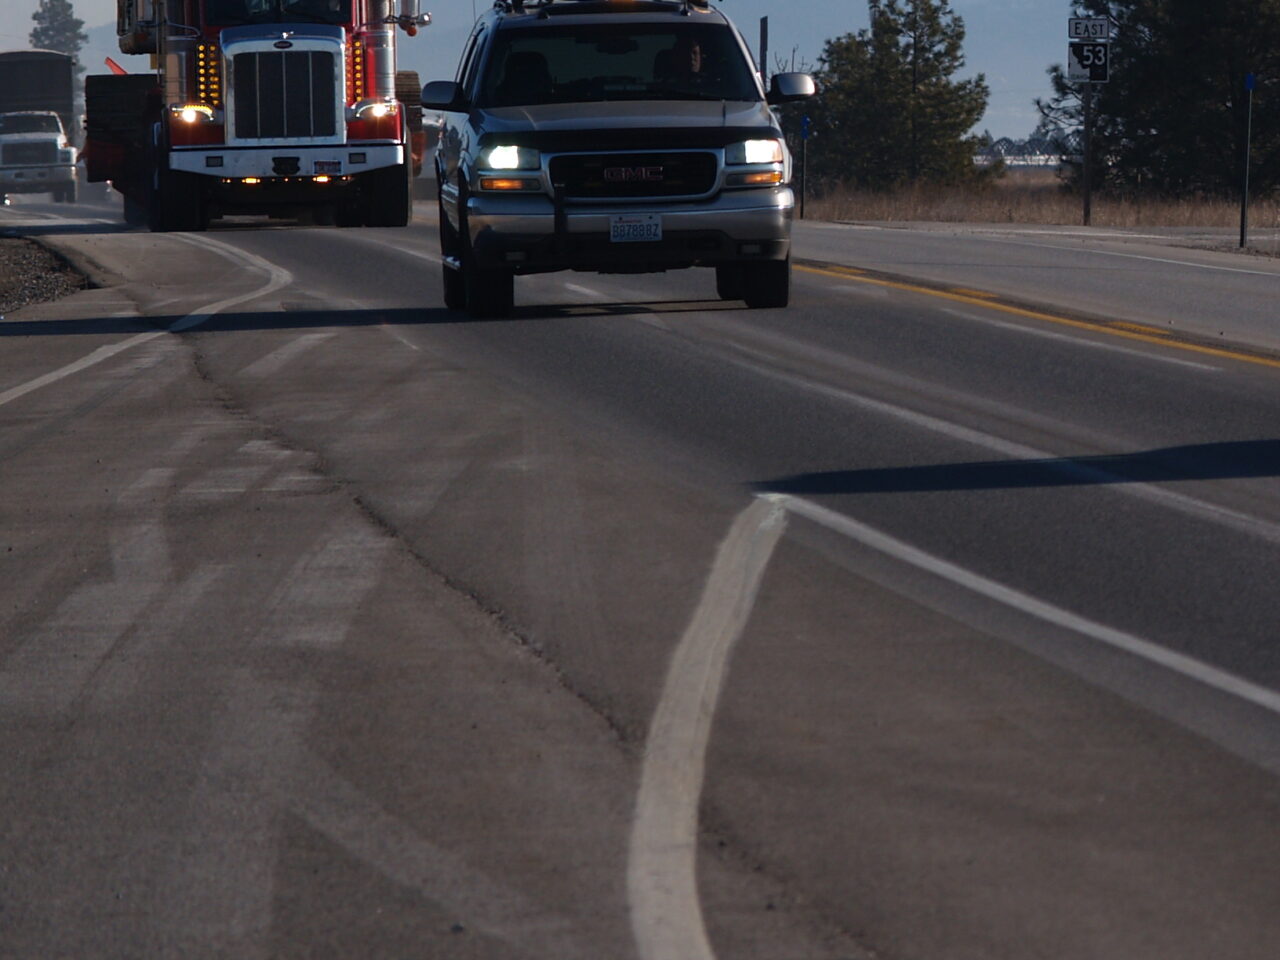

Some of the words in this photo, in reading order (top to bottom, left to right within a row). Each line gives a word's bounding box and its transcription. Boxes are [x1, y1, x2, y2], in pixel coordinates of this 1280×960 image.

[1074, 22, 1105, 35] EAST
[1082, 46, 1105, 65] 53
[603, 166, 664, 181] GMC
